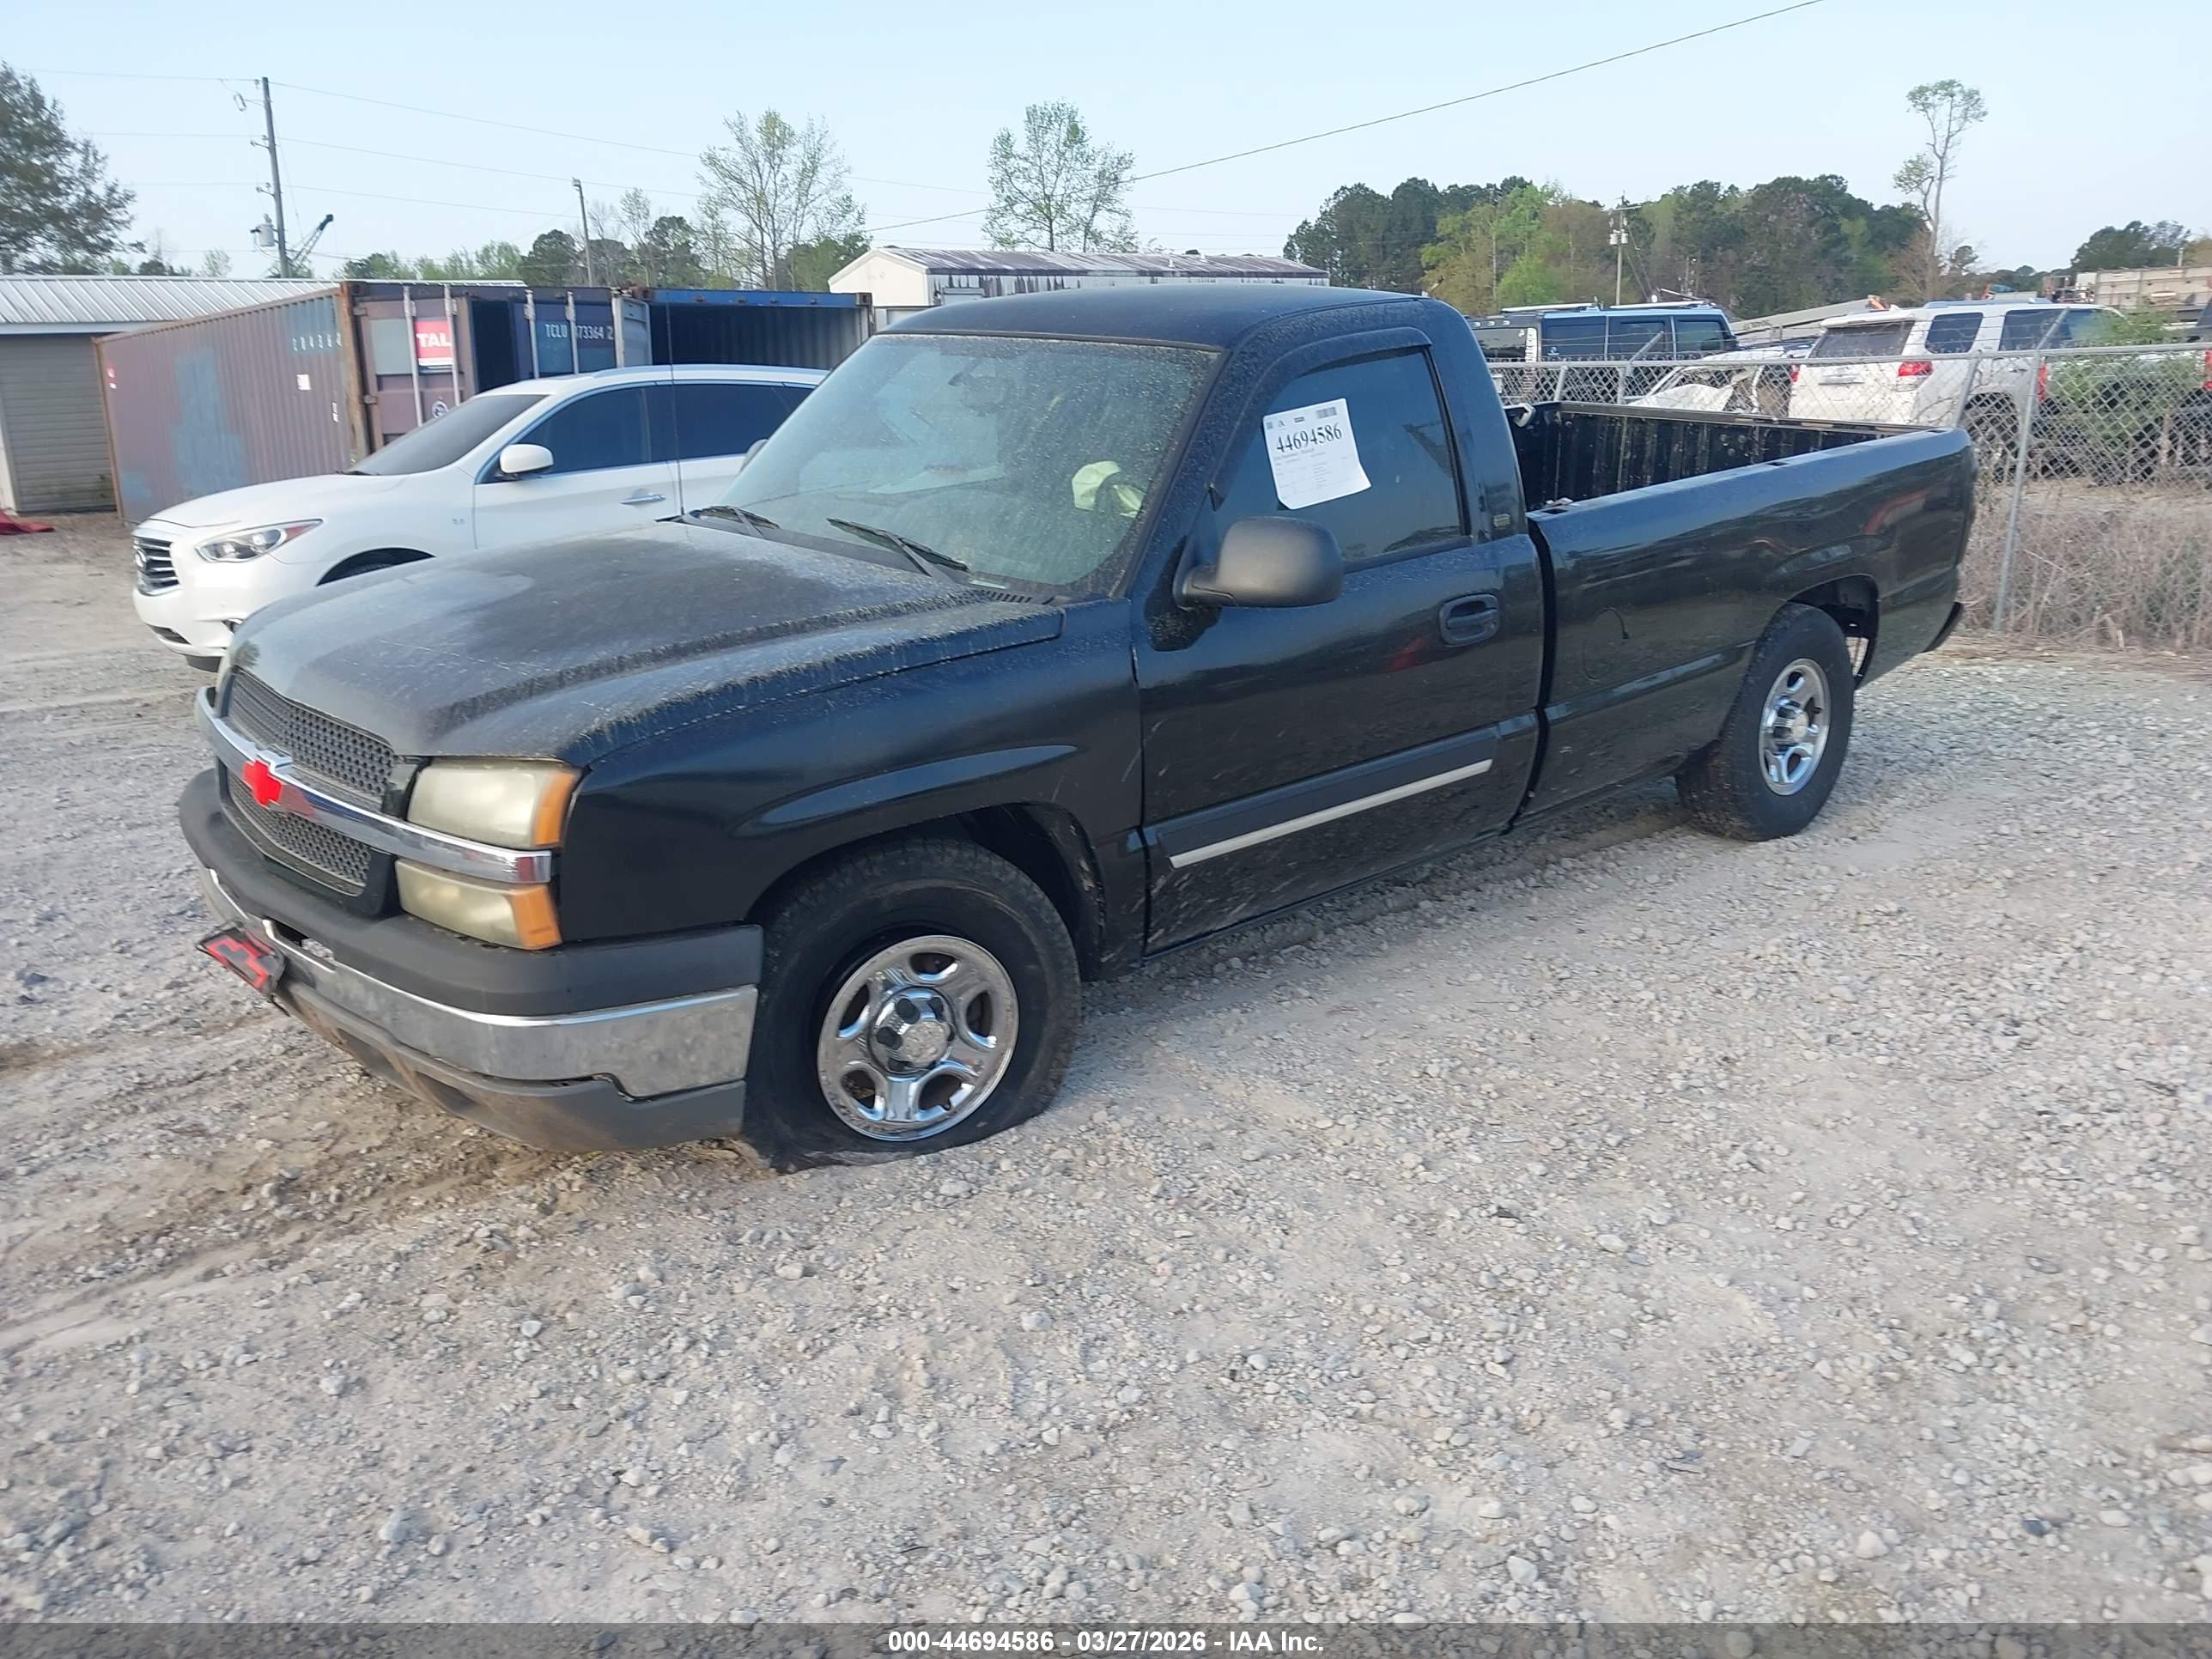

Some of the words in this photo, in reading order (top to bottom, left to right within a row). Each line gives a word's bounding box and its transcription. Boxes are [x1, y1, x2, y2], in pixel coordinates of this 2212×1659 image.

[416, 332, 453, 348] TAL
[605, 325, 613, 340] 2
[1277, 422, 1342, 453] 44694586
